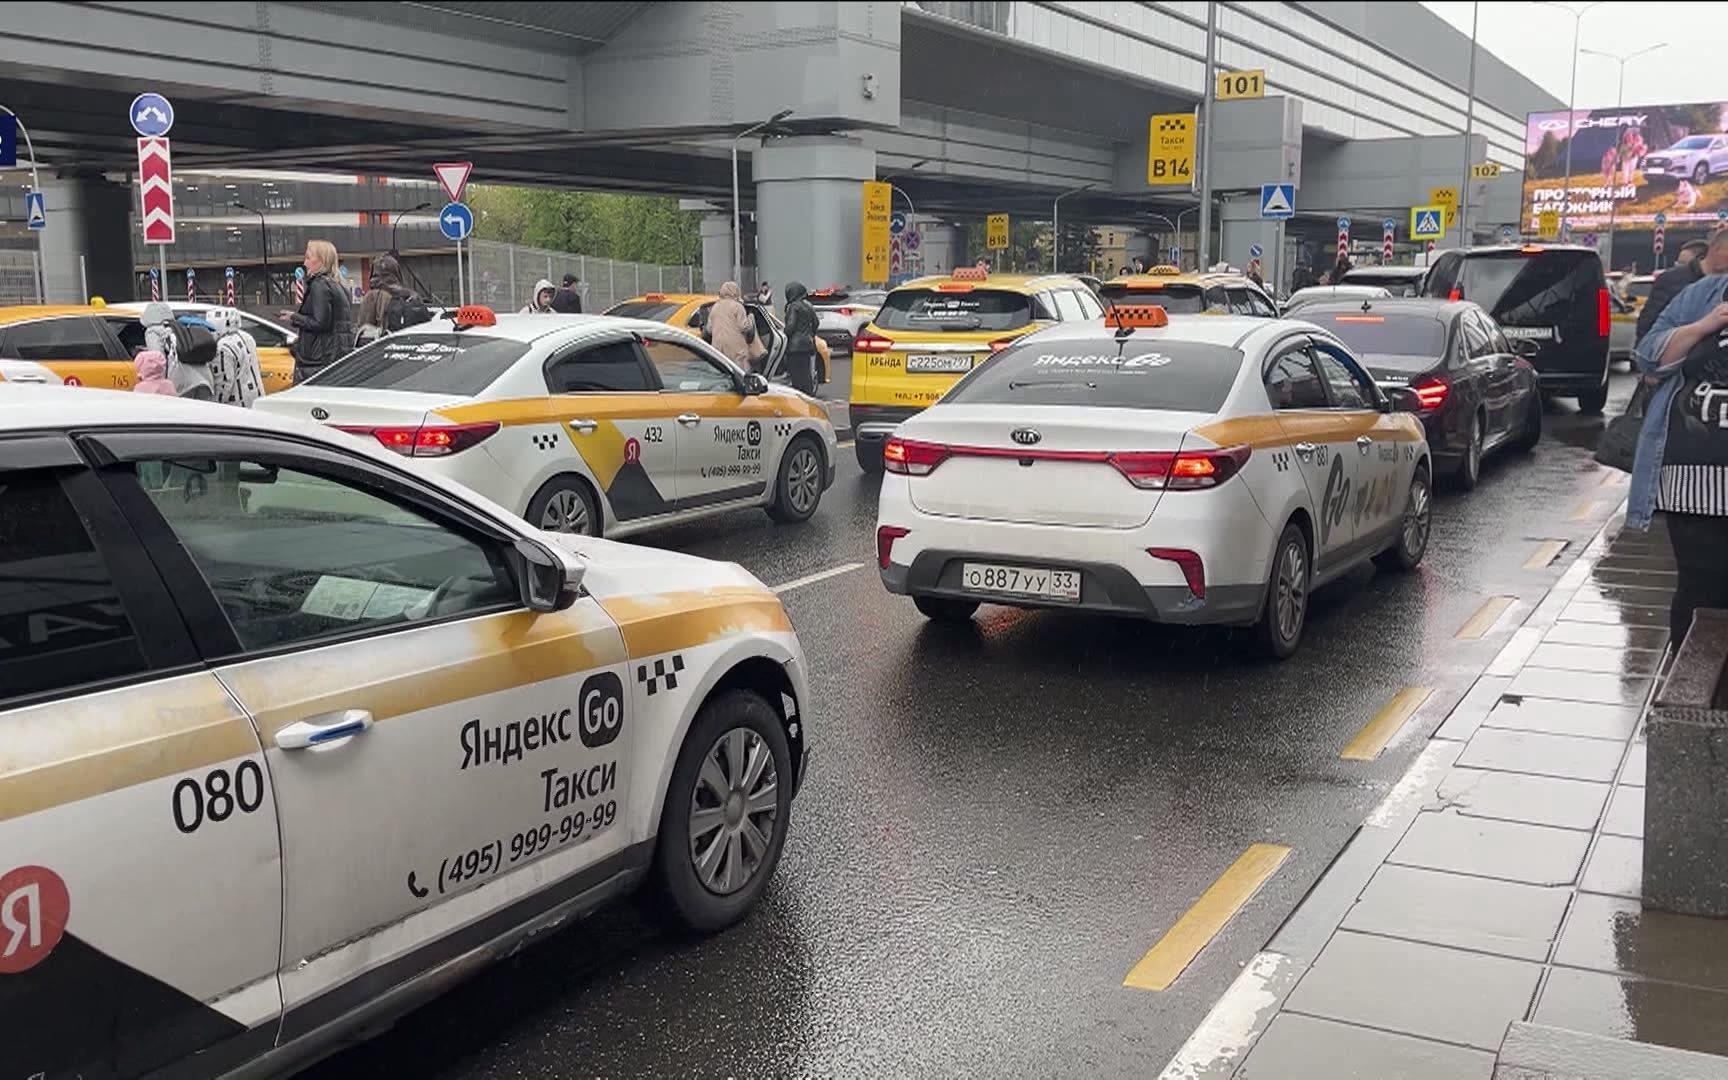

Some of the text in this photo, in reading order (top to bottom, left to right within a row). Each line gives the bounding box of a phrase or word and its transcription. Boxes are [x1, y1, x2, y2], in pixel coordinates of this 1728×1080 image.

[1223, 75, 1259, 95] 101
[1576, 115, 1648, 128] CHERY
[1161, 136, 1185, 145] Такси
[1474, 166, 1498, 176] 102
[870, 358, 901, 367] АРЕНДА
[644, 427, 663, 442] 432
[714, 426, 745, 443] Яндекс
[1013, 430, 1037, 443] KIA
[737, 445, 761, 460] Такси
[460, 708, 572, 770] Яндекс
[541, 760, 617, 812] Такси
[172, 759, 264, 833] 080
[438, 799, 617, 894] (495) 999-99-99
[1, 882, 42, 958] Я
